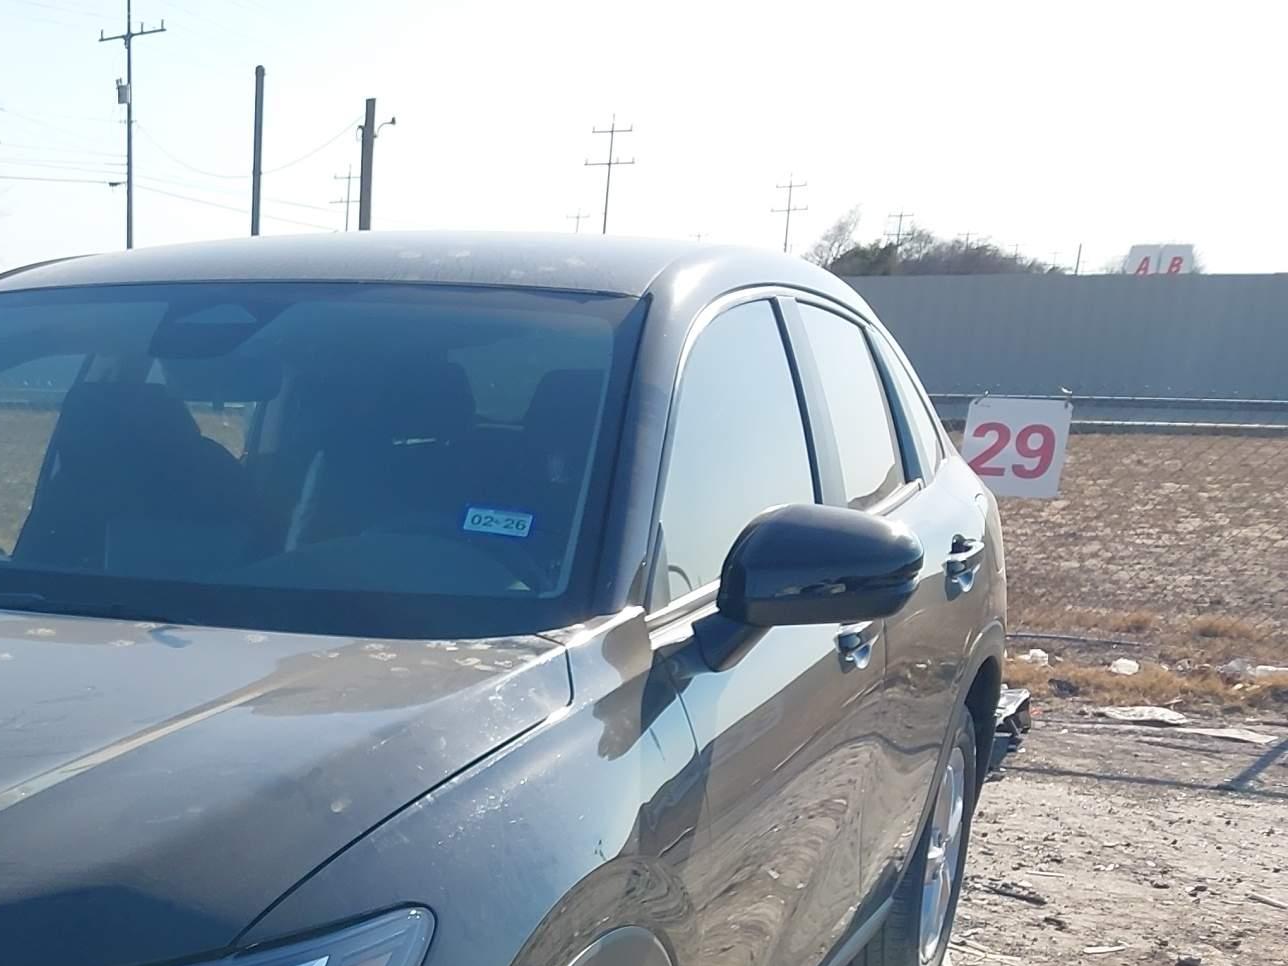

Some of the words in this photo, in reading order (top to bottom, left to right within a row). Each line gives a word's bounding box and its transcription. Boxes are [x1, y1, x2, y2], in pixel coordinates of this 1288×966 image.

[1135, 255, 1151, 275] A
[1167, 255, 1184, 274] B
[968, 421, 1056, 480] 29
[470, 513, 527, 531] 02-26
